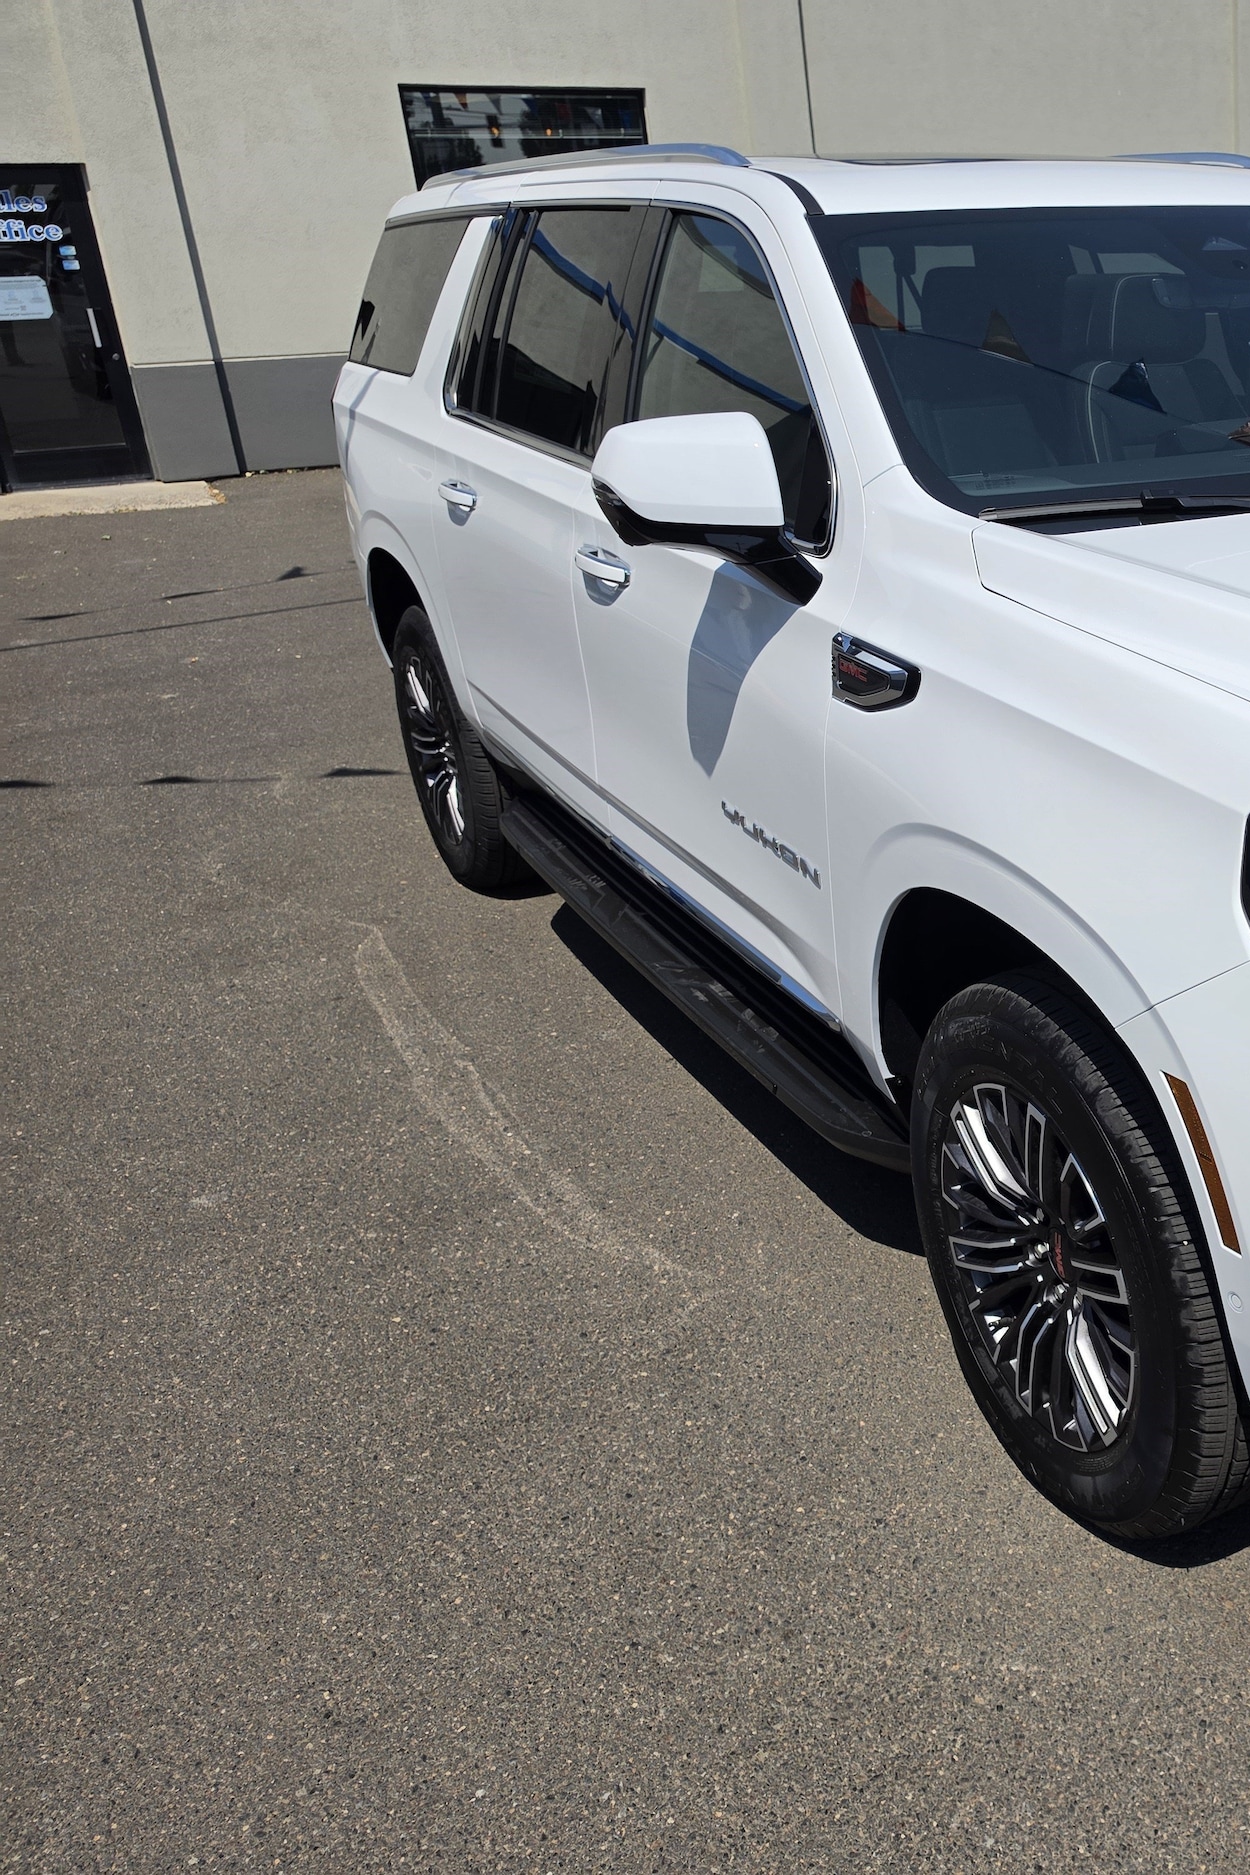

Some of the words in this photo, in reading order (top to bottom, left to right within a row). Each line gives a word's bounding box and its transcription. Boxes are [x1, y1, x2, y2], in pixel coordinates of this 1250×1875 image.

[0, 189, 47, 212] les
[0, 218, 63, 241] fice
[839, 658, 868, 682] GMC
[720, 800, 822, 890] YUKON
[1053, 1231, 1066, 1280] GMC
